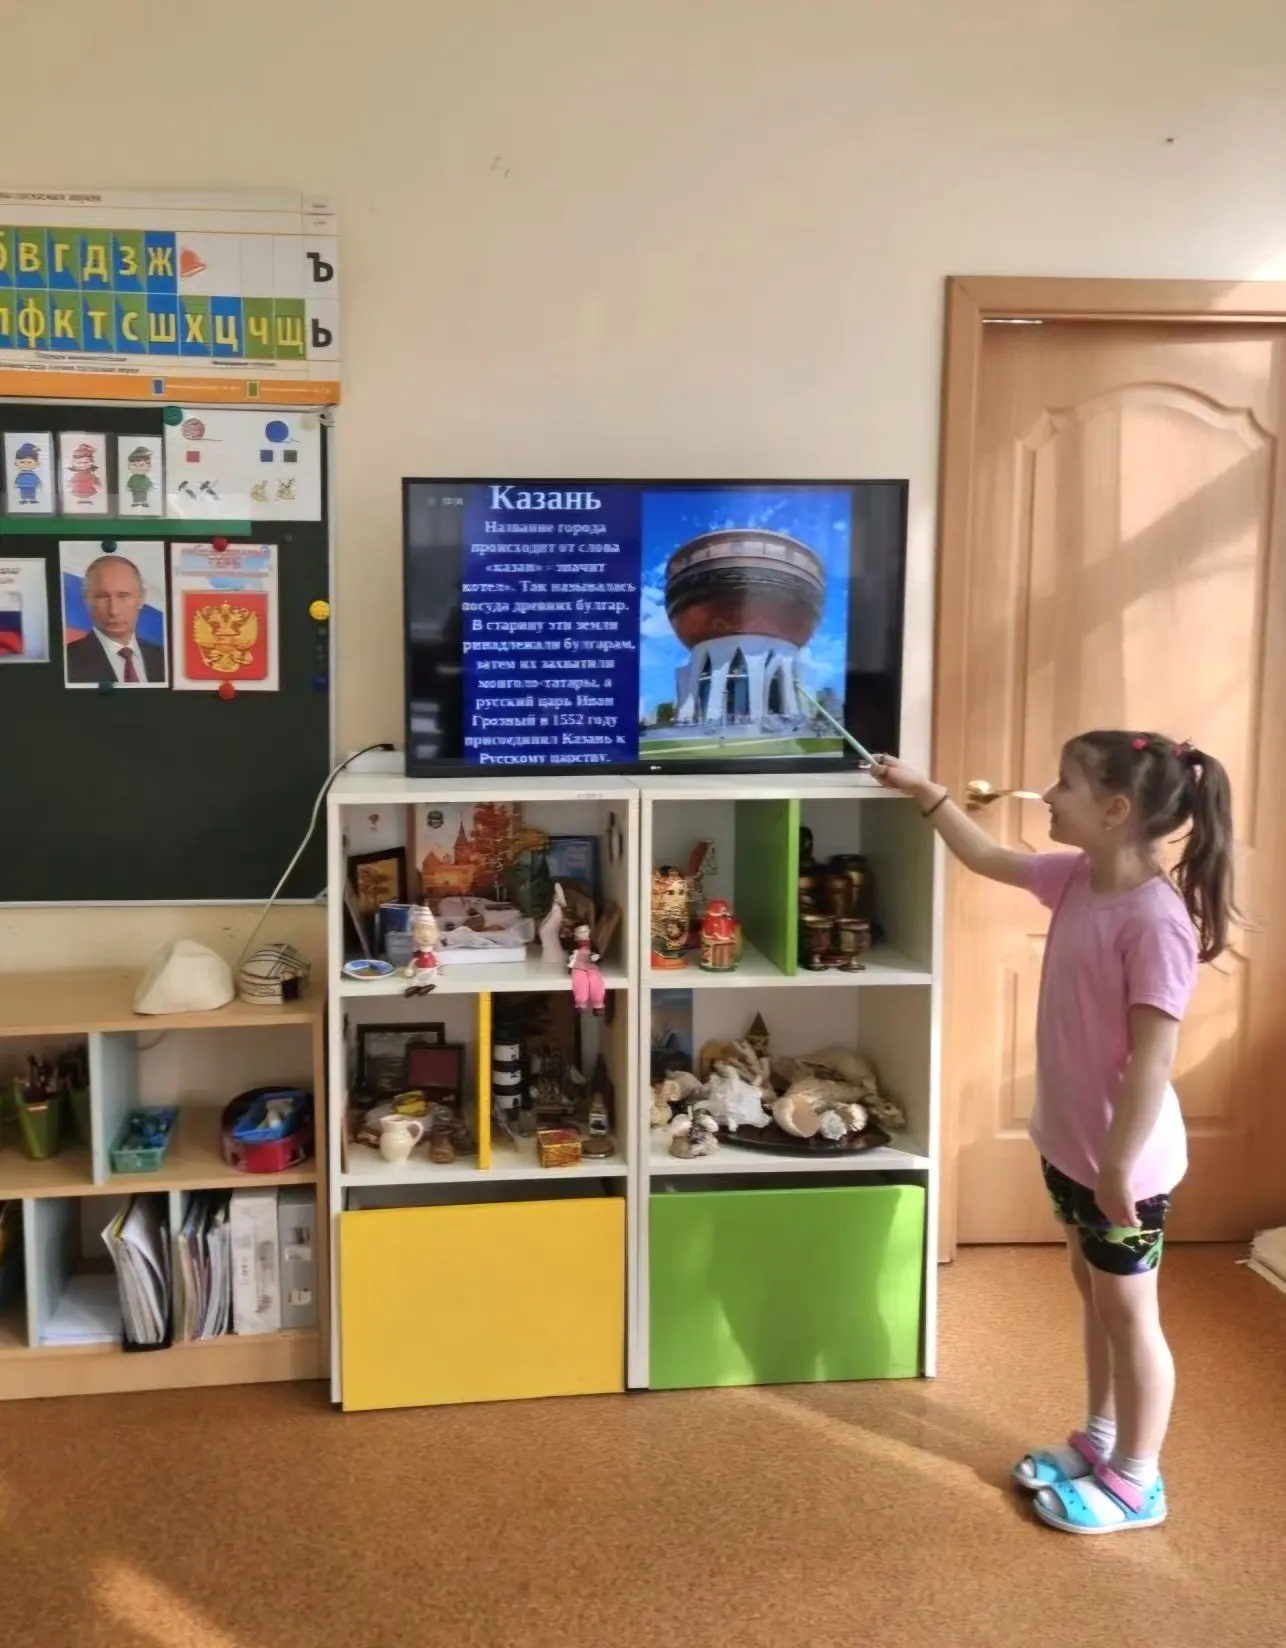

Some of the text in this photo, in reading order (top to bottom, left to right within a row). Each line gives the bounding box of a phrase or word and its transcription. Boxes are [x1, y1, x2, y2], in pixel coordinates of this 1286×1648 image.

[488, 485, 602, 510] Казань
[484, 520, 607, 536] Название города
[471, 543, 621, 556] происходит от слова
[519, 580, 548, 592] Так
[576, 599, 630, 614] булгар.
[472, 619, 619, 633] В старину эти земли
[462, 641, 561, 653] ринадлежали
[477, 660, 615, 669] затем их захватили
[603, 679, 613, 688] а
[476, 695, 615, 710] русский царь Иван
[472, 713, 619, 729] Грозный в 1552 году
[464, 733, 626, 748] присоединил Казань к
[480, 752, 546, 765] Русскому
